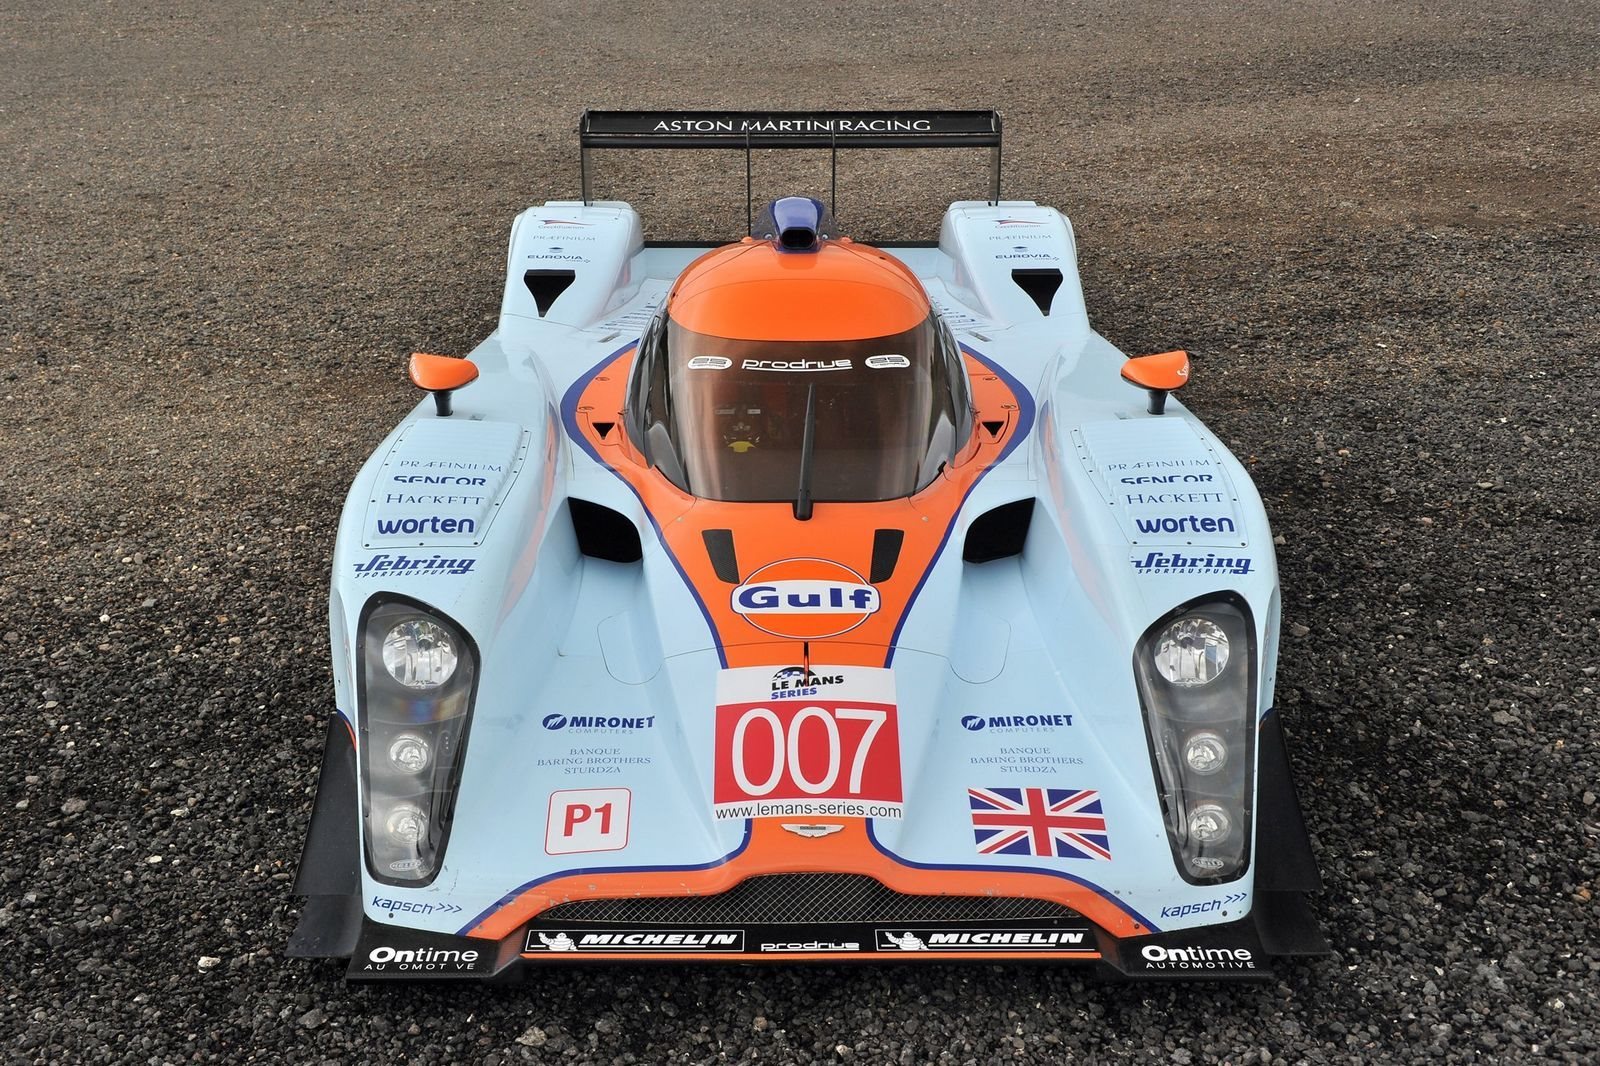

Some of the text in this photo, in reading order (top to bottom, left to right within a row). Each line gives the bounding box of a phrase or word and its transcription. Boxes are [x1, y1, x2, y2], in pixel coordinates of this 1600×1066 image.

[653, 120, 931, 131] ASTON MARTIN RACING
[741, 358, 853, 370] prodrive
[387, 493, 485, 505] HACKETT
[1126, 492, 1224, 505] HACKETT
[377, 516, 475, 535] worten
[1135, 515, 1235, 534] worten
[353, 554, 477, 575] Sebring
[1130, 552, 1255, 575] Sebring
[738, 586, 873, 609] Gulf
[772, 675, 844, 691] LE MANS
[771, 687, 818, 700] SERIES
[569, 715, 656, 729] MIRONET
[988, 714, 1073, 728] MIRONET
[989, 726, 1056, 734] COMPUTERS
[570, 748, 621, 756] BANQUE
[732, 706, 887, 796] 007
[1000, 747, 1051, 755] BANQUE
[537, 757, 651, 766] BARING BROTHERS
[1019, 757, 1084, 765] BROTHERS
[564, 766, 621, 775] STURDZA
[715, 801, 902, 819] www.lemans-series.com
[563, 803, 612, 837] P1
[371, 896, 436, 915] kapsch
[1160, 900, 1222, 918] kapsch
[580, 934, 737, 945] MICHELIN
[927, 933, 1085, 944] MICHELIN
[760, 941, 860, 951] prodrive
[369, 946, 479, 963] Ontime
[1141, 945, 1252, 961] Ontime
[1145, 961, 1256, 969] AUTOMOTIVE
